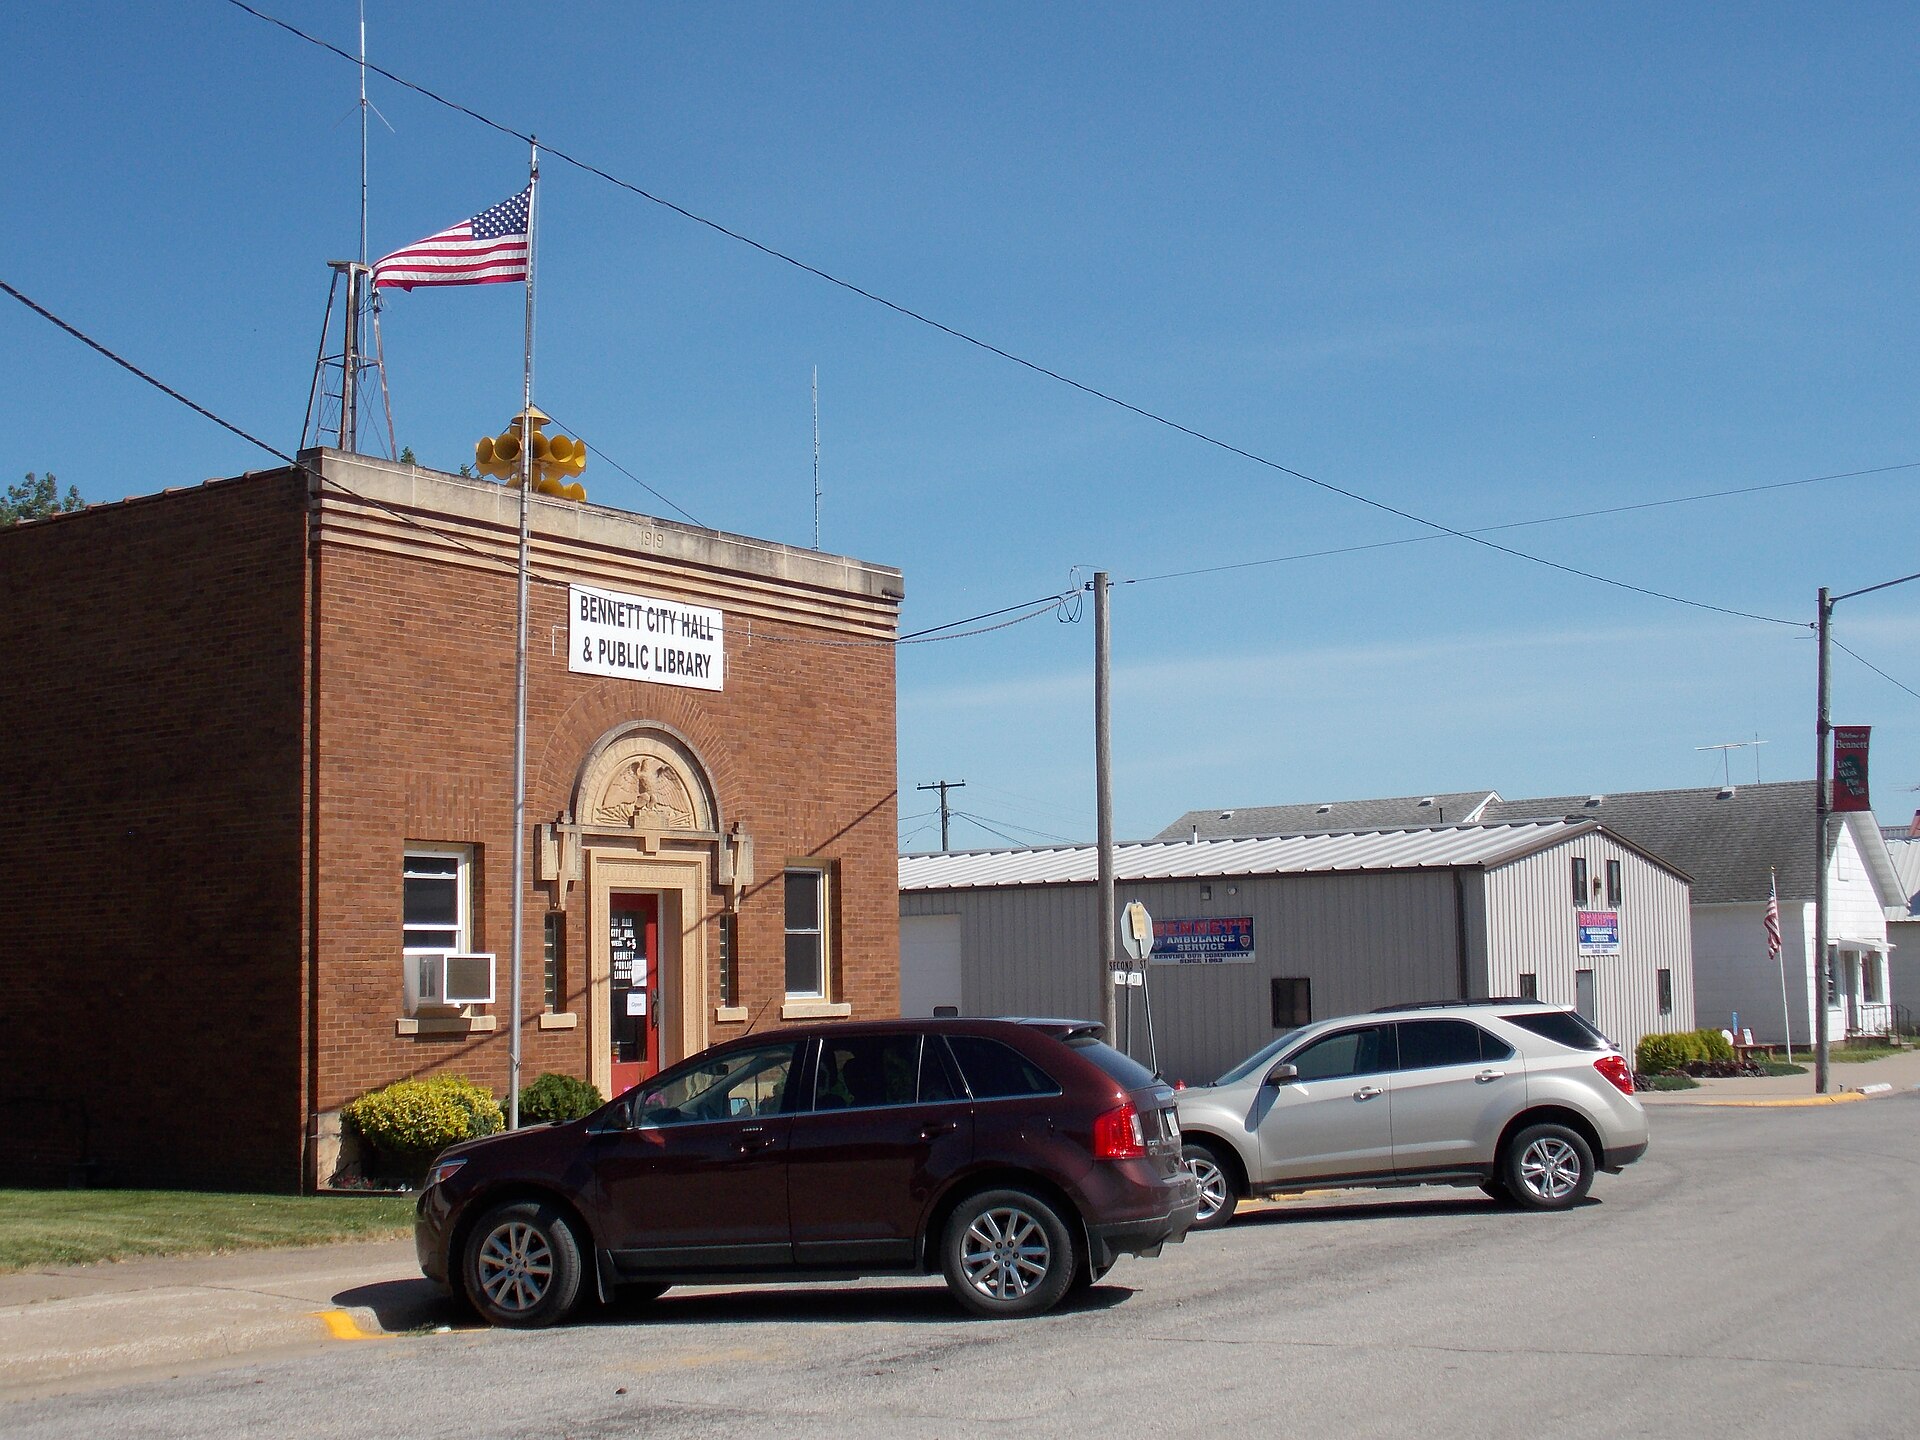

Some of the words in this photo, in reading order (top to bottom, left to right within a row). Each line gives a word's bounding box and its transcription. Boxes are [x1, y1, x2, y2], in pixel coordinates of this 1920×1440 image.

[641, 531, 664, 548] 1919
[580, 595, 642, 630] BENNETT
[647, 607, 677, 635] CITY
[681, 612, 714, 641] HALL
[583, 636, 592, 663] &
[599, 638, 649, 670] PUBLIC
[655, 646, 711, 679] LIBRARY
[1836, 740, 1868, 749] Bennett
[1153, 918, 1250, 937] BENNETT
[1167, 934, 1236, 944] AMBULANCE
[1177, 943, 1225, 951] SERVICE
[613, 951, 635, 961] BENNETT
[1109, 960, 1133, 971] SECOND
[1140, 960, 1147, 970] ST
